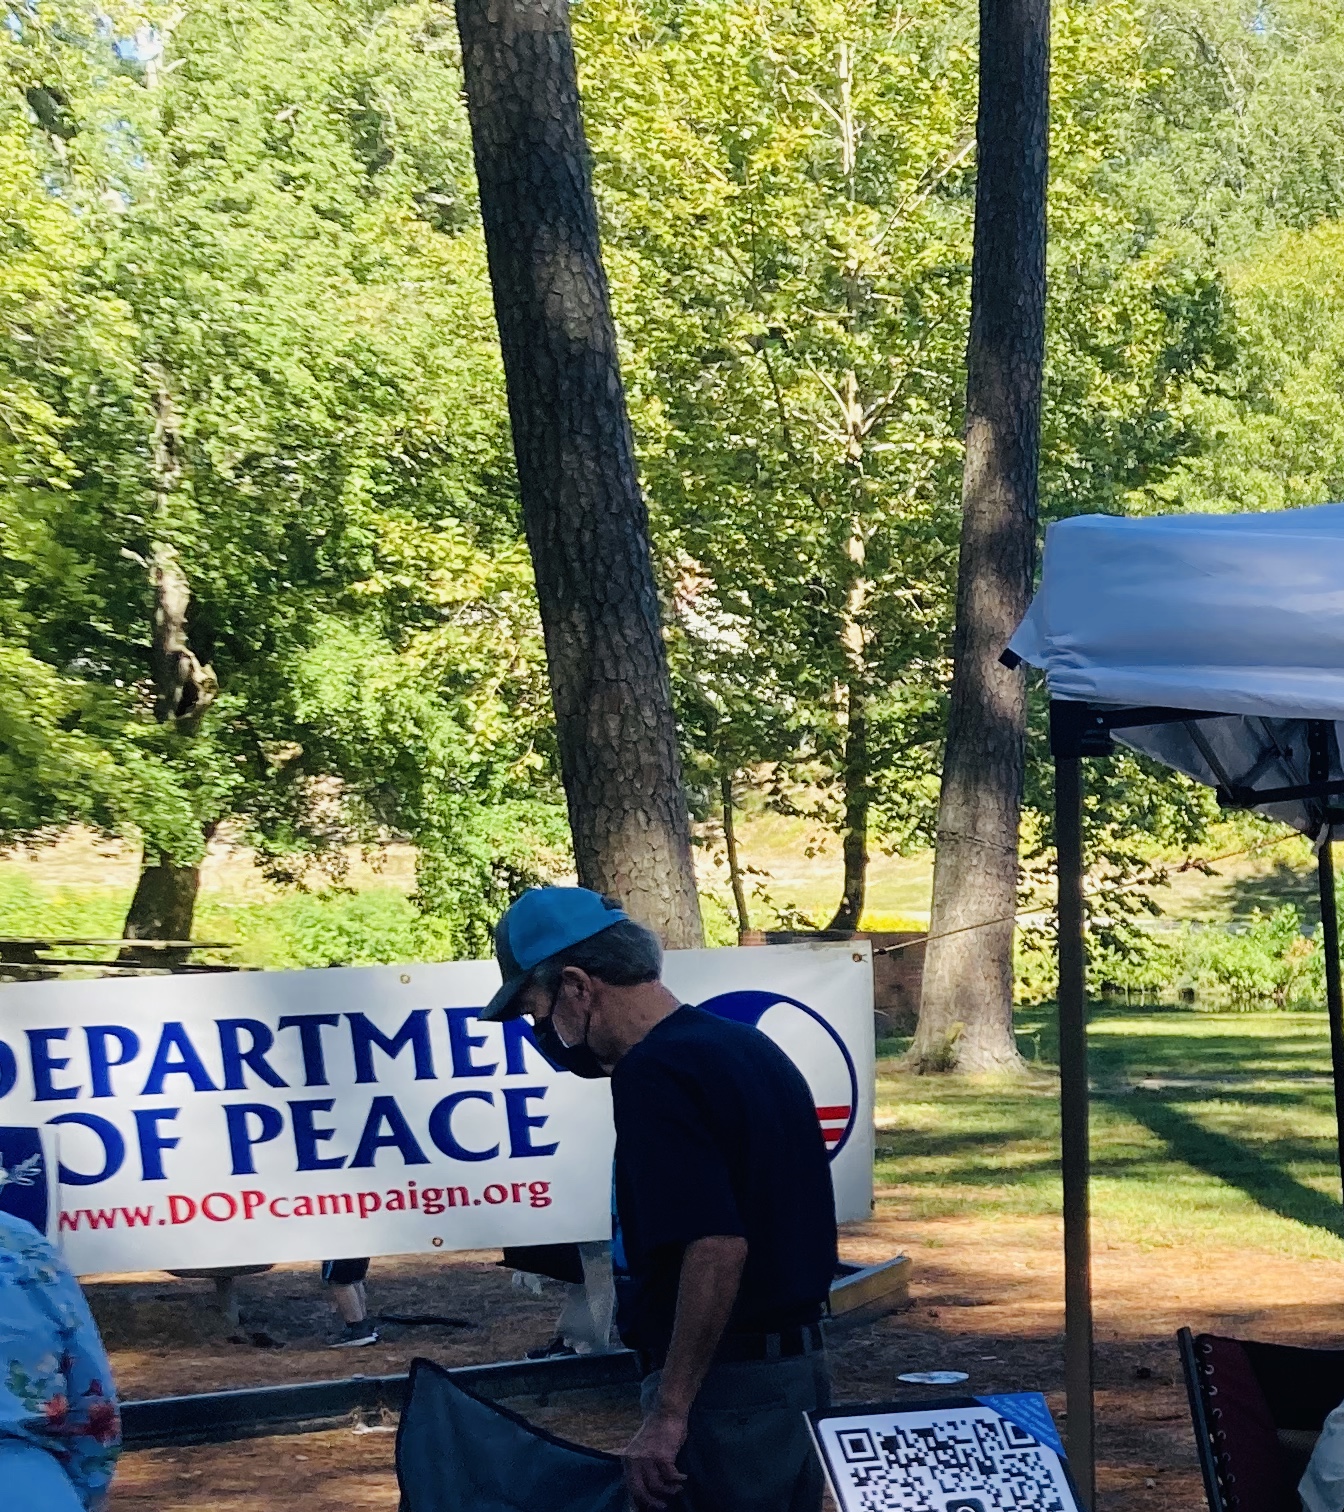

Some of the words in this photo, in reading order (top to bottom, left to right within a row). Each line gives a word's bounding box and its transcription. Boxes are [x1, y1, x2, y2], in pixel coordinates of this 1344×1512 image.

[0, 1005, 573, 1103] EPARTMEN
[44, 1107, 182, 1186] OF
[221, 1086, 561, 1177] PEACE
[59, 1180, 553, 1233] www.DOPcampaign.org
